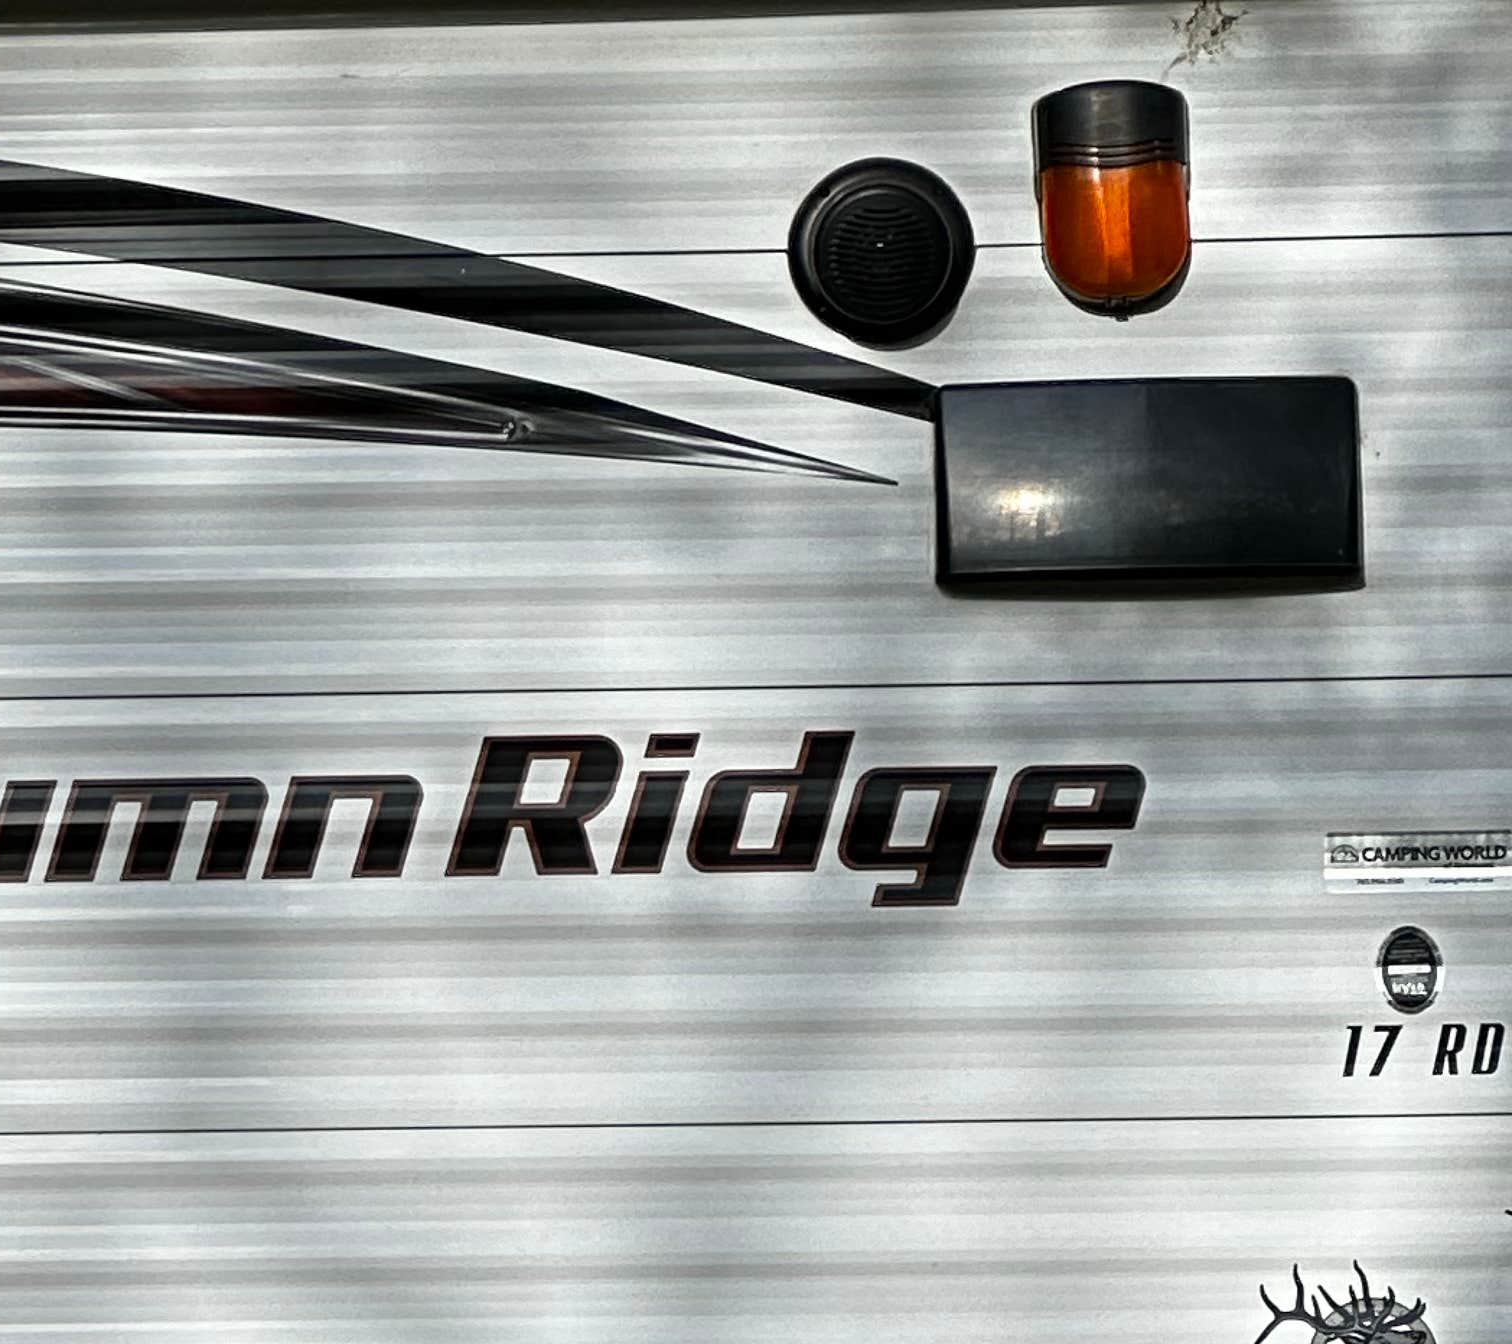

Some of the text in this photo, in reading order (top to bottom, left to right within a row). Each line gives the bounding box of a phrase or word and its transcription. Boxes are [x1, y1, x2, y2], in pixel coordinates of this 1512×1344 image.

[444, 731, 1147, 907] Ridge
[1361, 845, 1508, 862] CAMPING WORLD
[1342, 1022, 1505, 1077] 17 RD
